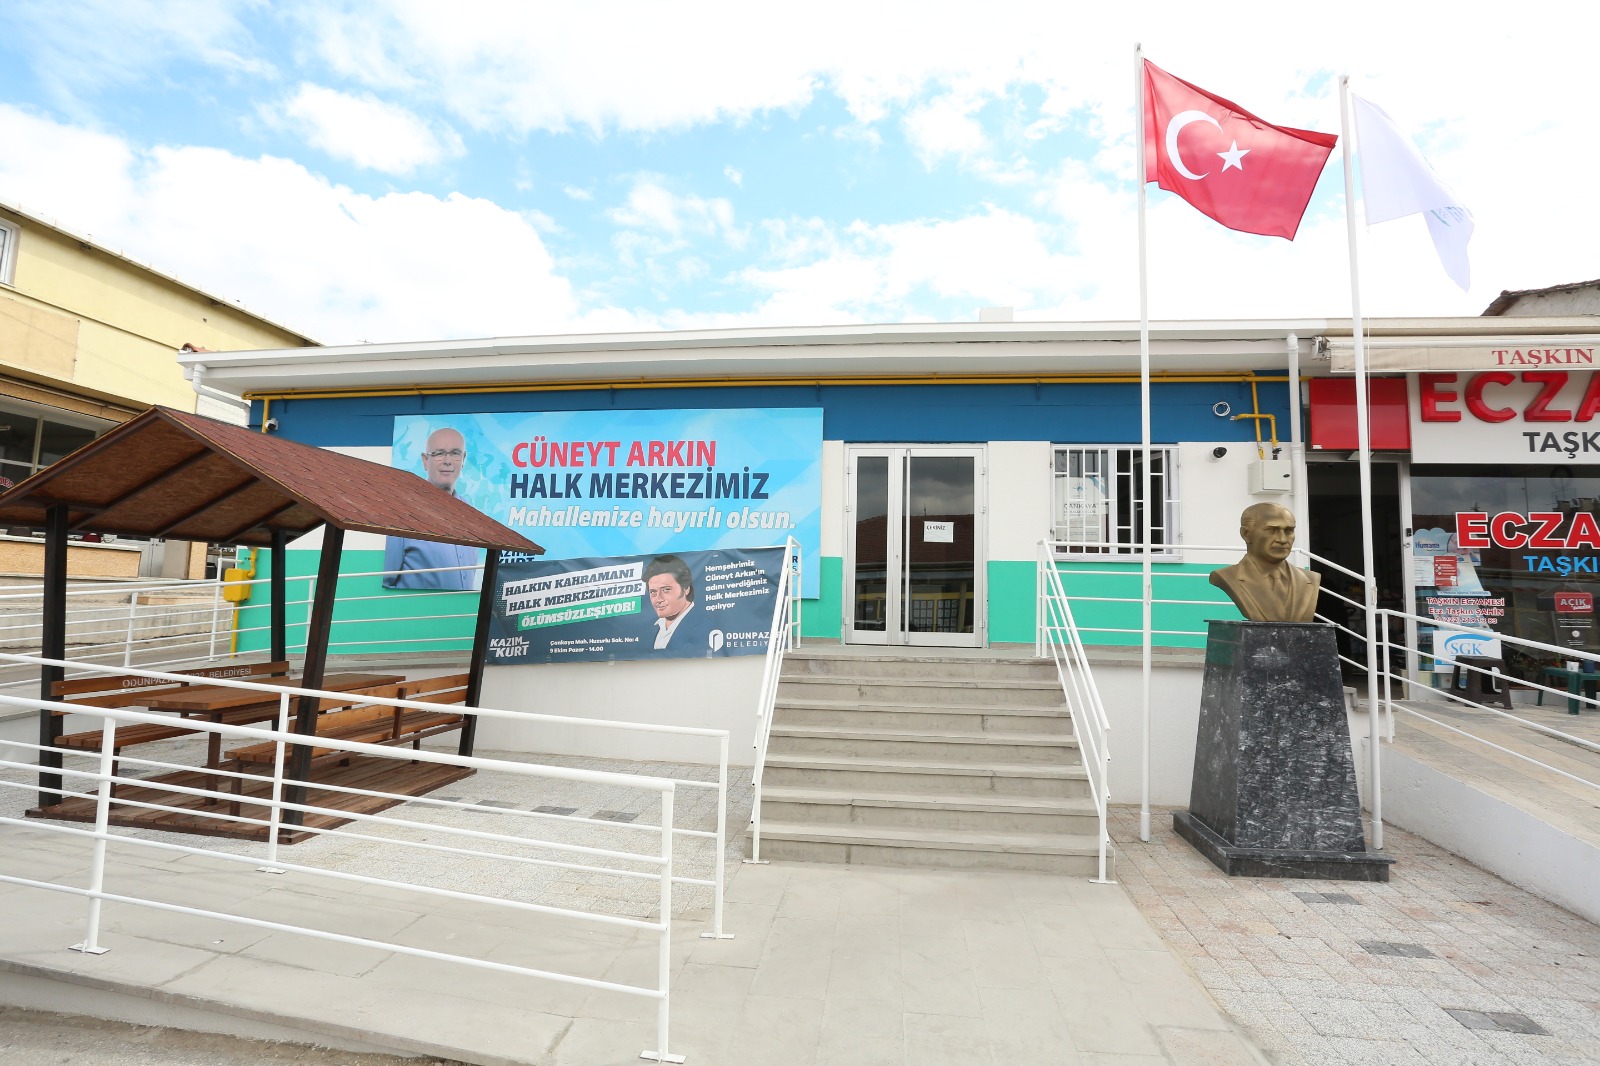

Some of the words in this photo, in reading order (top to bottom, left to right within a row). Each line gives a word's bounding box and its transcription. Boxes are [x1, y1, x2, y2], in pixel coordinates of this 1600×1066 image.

[1491, 348, 1595, 368] TAŞKIN
[511, 435, 621, 468] CÜNEYT
[626, 440, 717, 468] ARKIN
[510, 472, 583, 499] HALK
[589, 466, 770, 499] MERKEZİMİZ
[507, 505, 643, 528] Mahallemize
[647, 506, 722, 534] hayırlı
[726, 506, 797, 529] olsun.
[705, 560, 755, 573] Hemşehrimiz
[504, 580, 552, 597] HALKIN
[554, 568, 635, 589] KAHRAMANI
[705, 572, 734, 582] Cüneyt
[705, 584, 725, 592] adını
[726, 577, 768, 588] verdiğimiz
[508, 597, 541, 612] HALK
[543, 582, 643, 607] MERKEZİMİZDE
[705, 593, 724, 601] Halk
[724, 587, 770, 599] Merkezimiz
[705, 602, 735, 611] açılıyor
[1426, 597, 1459, 606] TAŞKIN
[1461, 597, 1505, 606] ECZANESİ
[1560, 598, 1586, 607] AÇIK
[521, 601, 636, 627] ÖLÜMSÜZLEŞİYOR!
[1447, 607, 1473, 616] Taşkın
[1475, 607, 1505, 617] ŞAHİN
[490, 636, 523, 647] KAZIM
[726, 631, 780, 640] ODUNPAZ
[550, 639, 574, 647] Çankaya
[726, 640, 780, 648] BELEDİY
[1451, 642, 1484, 655] SGK
[495, 645, 530, 658] KURT
[209, 666, 252, 678] BELEDİYESİ
